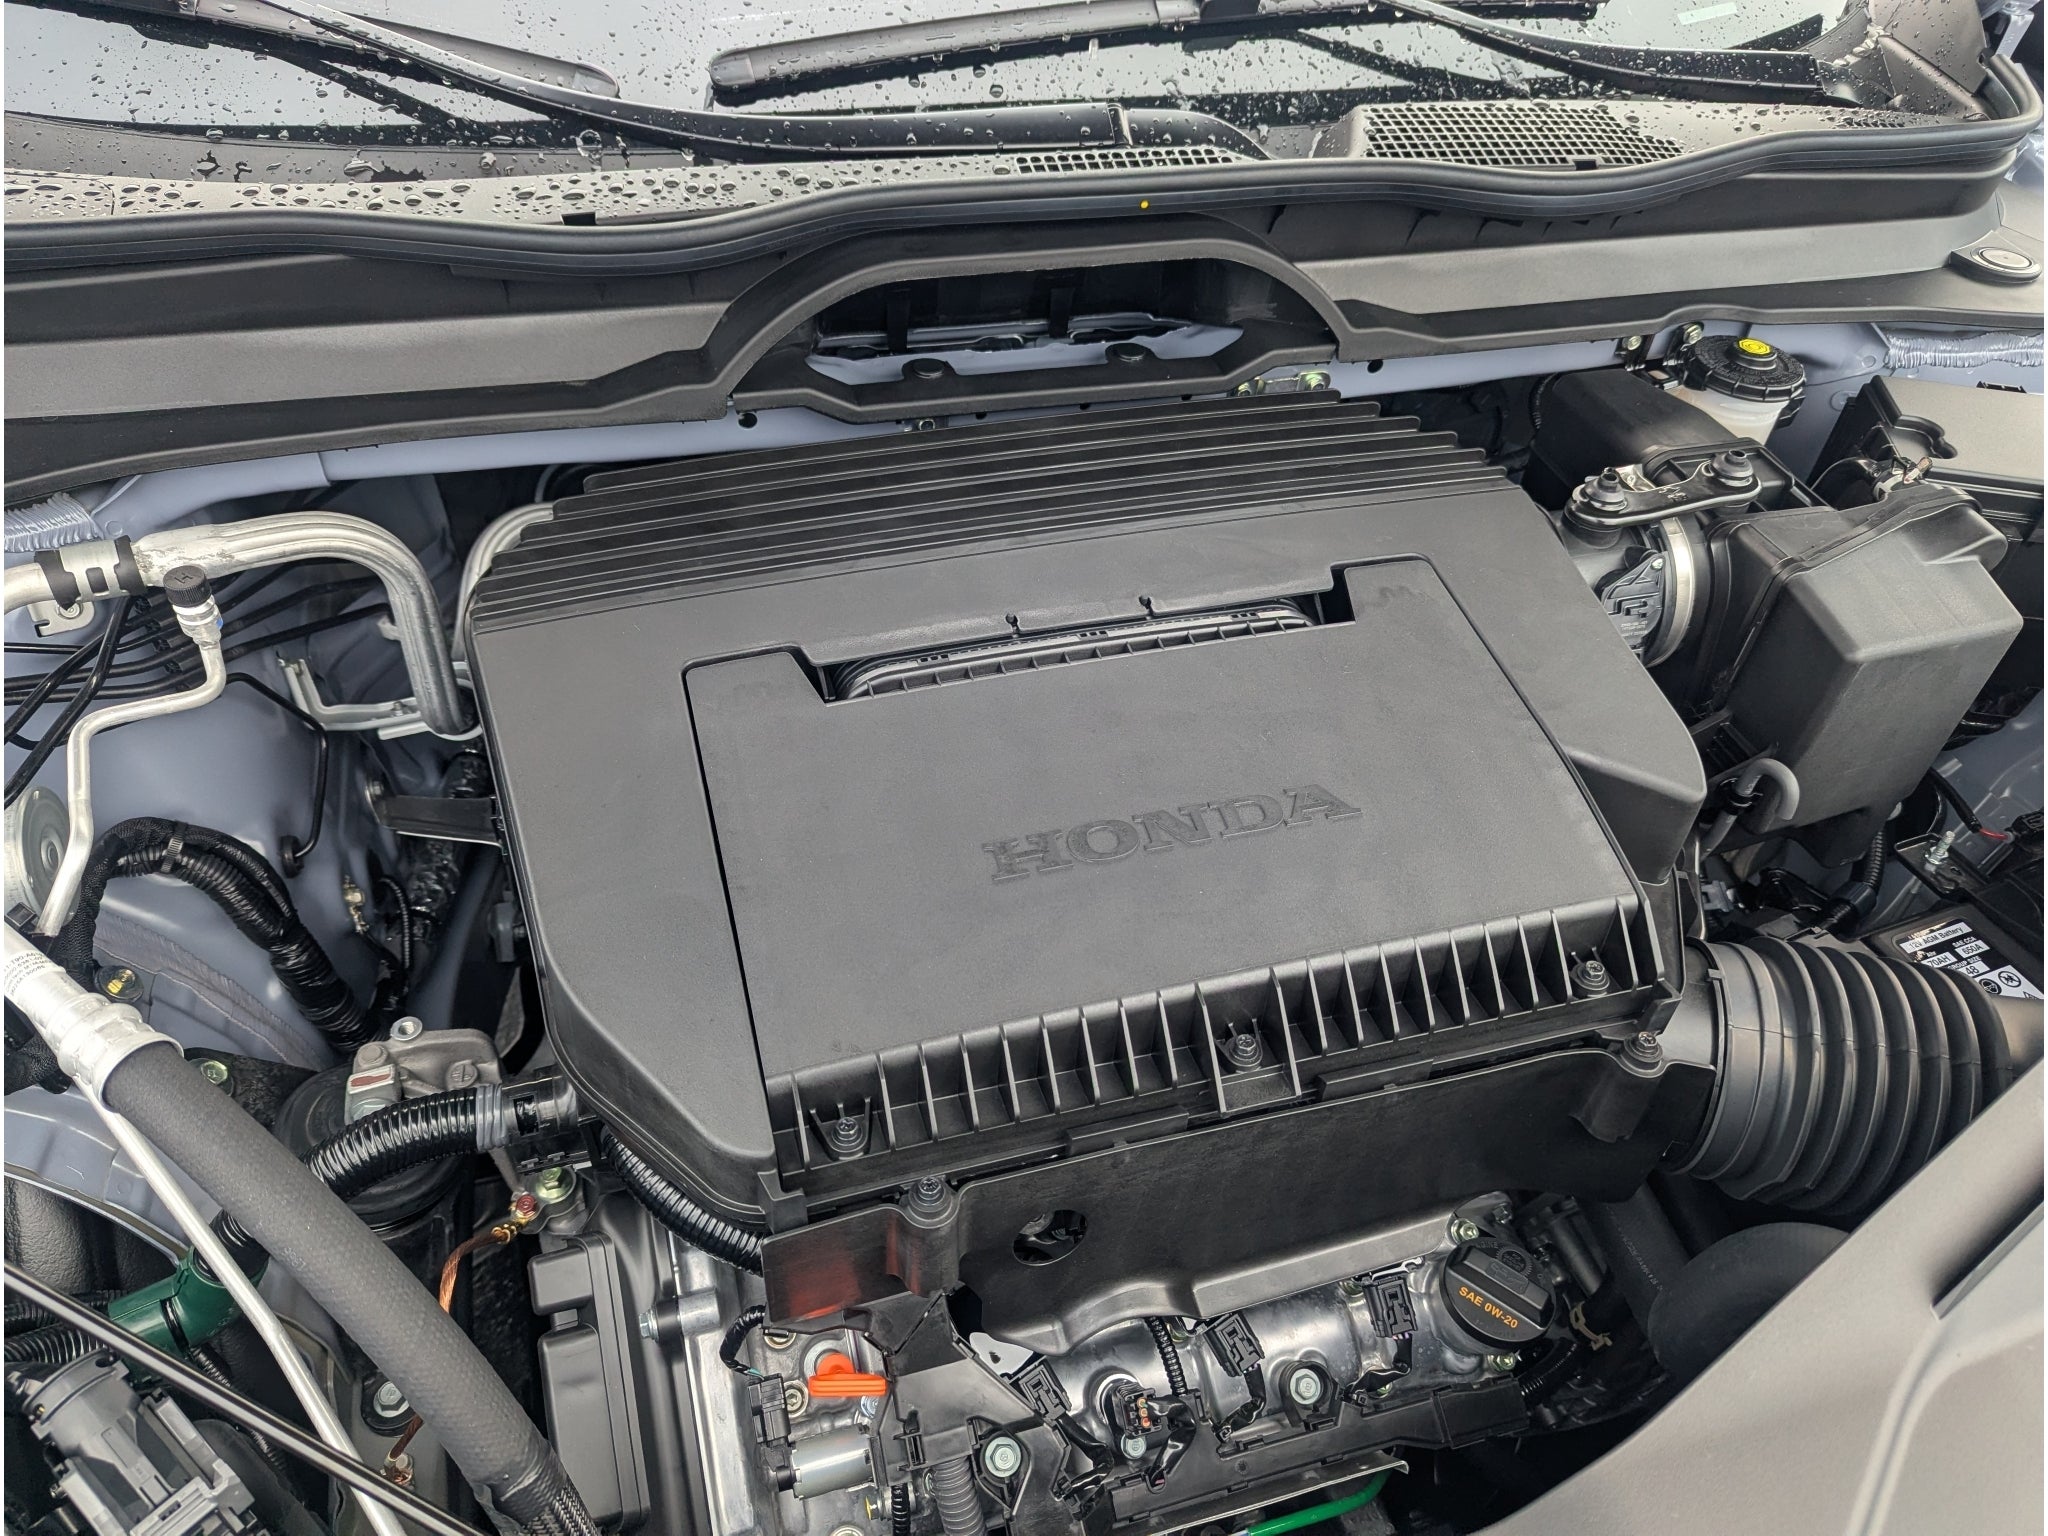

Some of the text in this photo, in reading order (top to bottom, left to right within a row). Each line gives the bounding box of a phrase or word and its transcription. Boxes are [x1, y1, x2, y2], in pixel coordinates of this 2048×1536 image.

[981, 784, 1363, 882] HONDA
[1923, 935, 1939, 945] AGM
[1939, 926, 1964, 939] Battery
[1963, 944, 1983, 956] 650A
[1927, 955, 1951, 968] 70AH
[1965, 964, 1980, 976] 48
[1458, 1286, 1484, 1307] SAE
[1484, 1302, 1518, 1328] 0W-20
